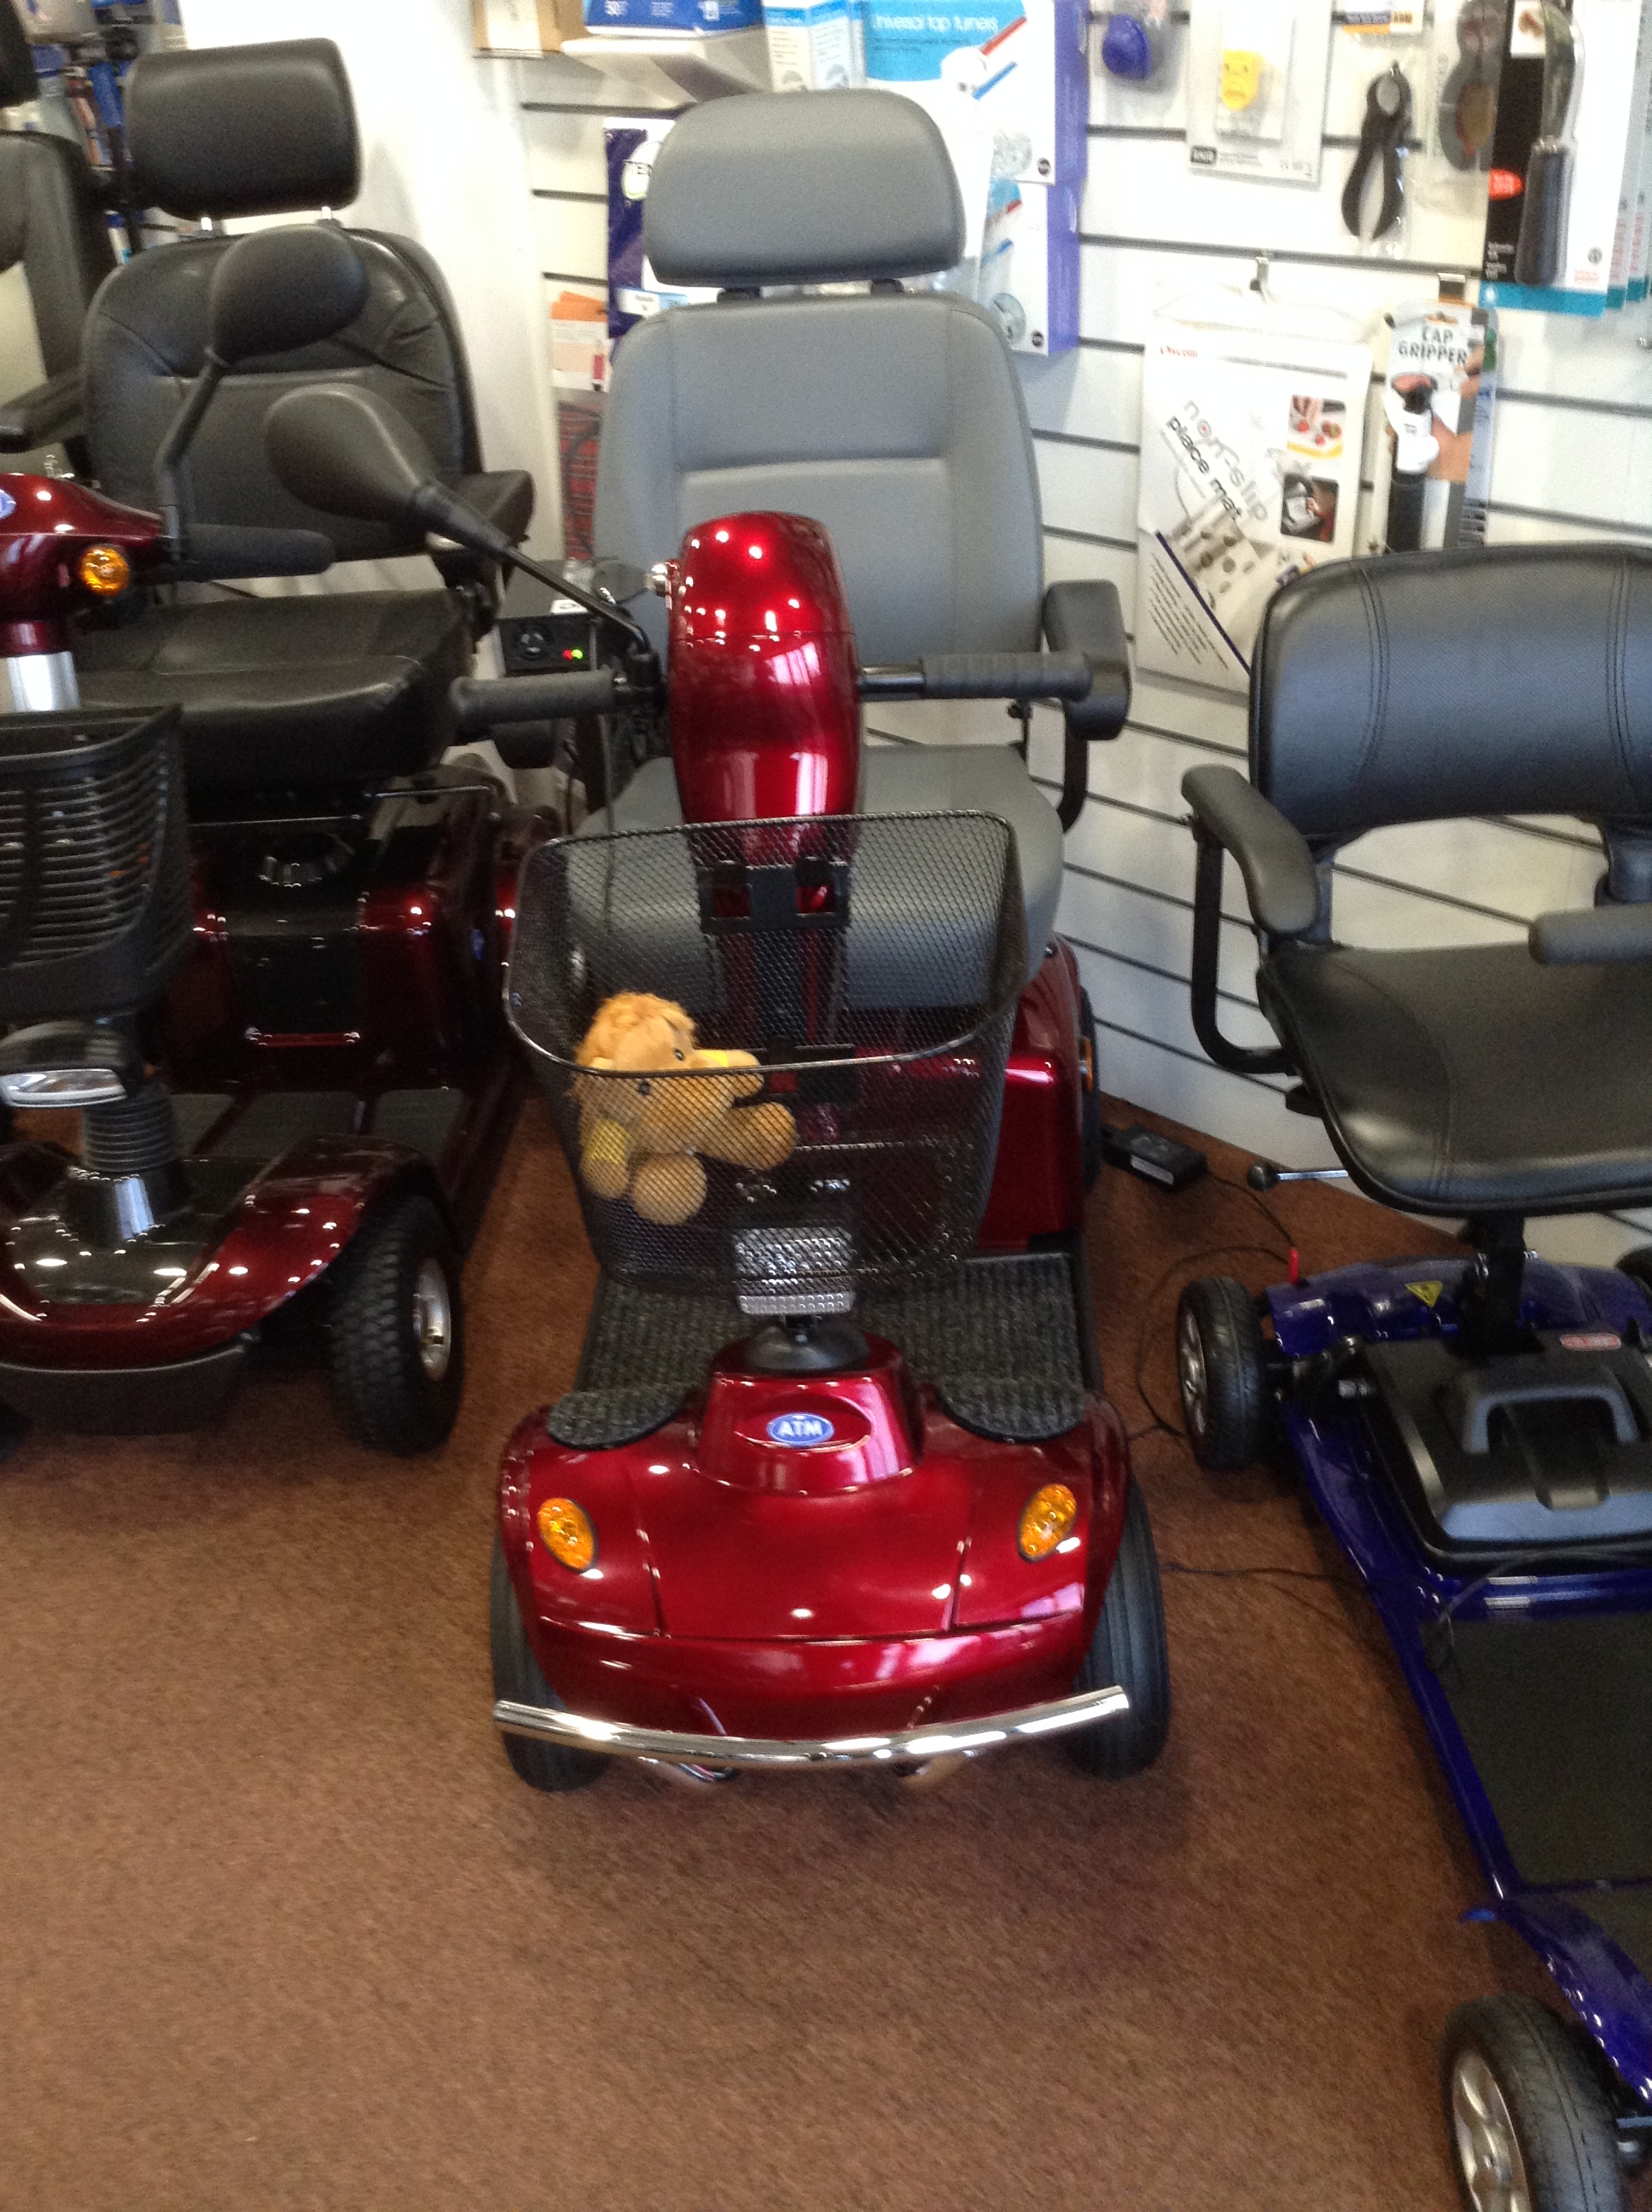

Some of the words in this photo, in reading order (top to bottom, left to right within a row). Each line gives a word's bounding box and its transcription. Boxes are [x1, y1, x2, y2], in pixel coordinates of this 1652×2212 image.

[1422, 325, 1454, 343] CAP
[1398, 341, 1468, 365] GRIPPER
[1166, 415, 1211, 475] place
[777, 1419, 824, 1438] ATM
